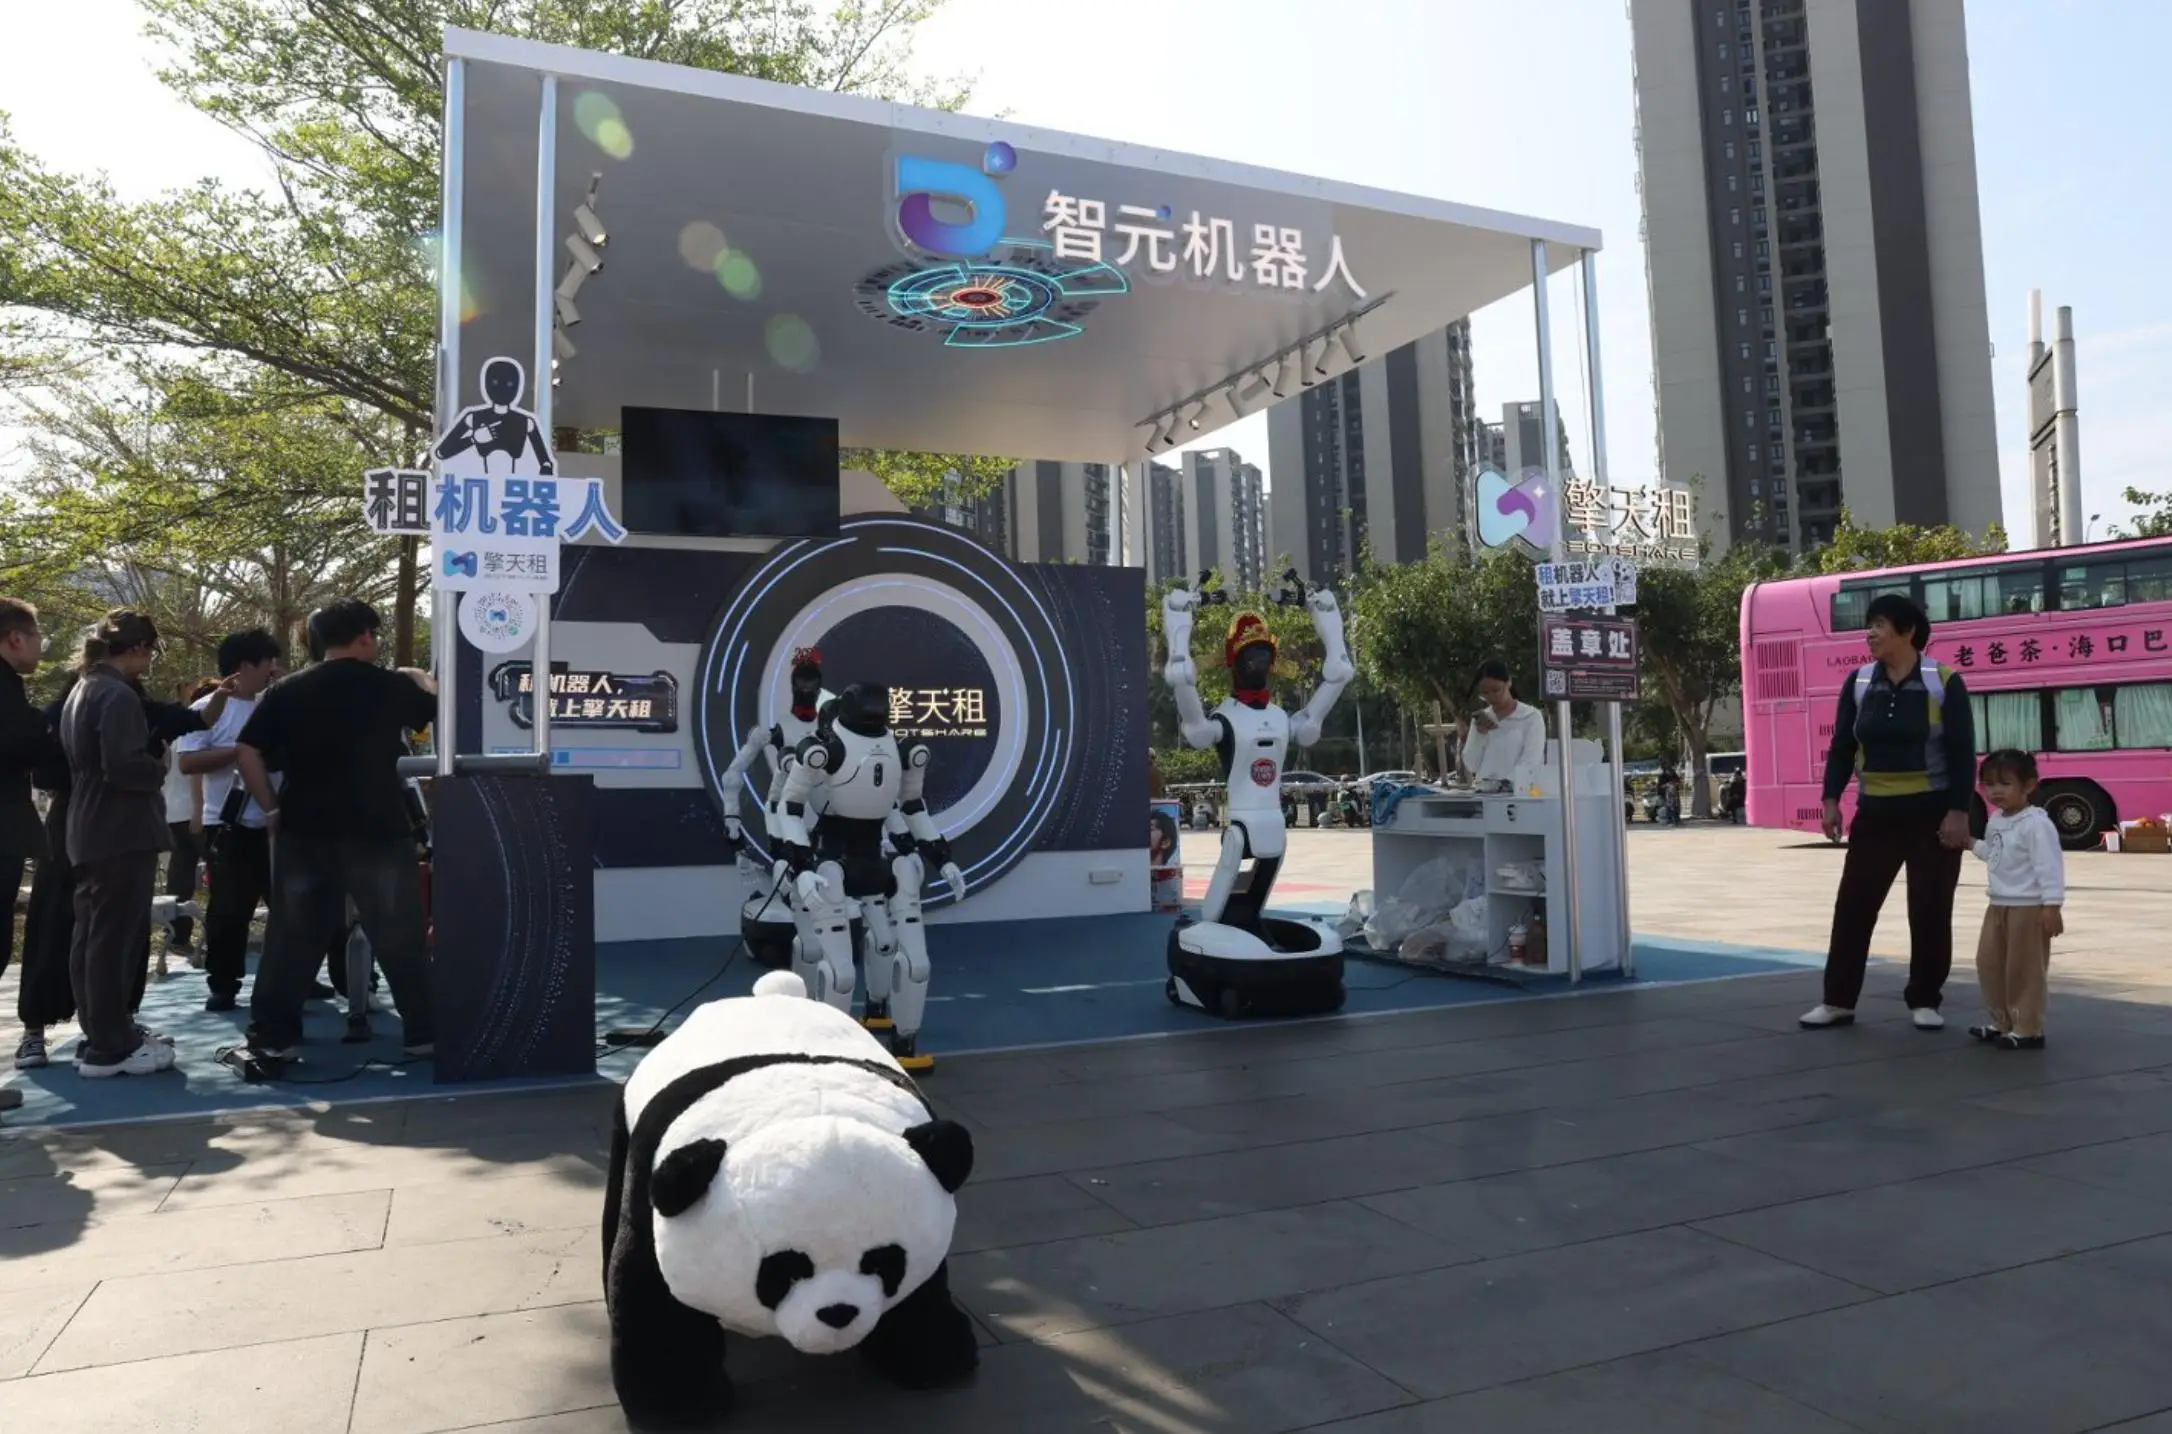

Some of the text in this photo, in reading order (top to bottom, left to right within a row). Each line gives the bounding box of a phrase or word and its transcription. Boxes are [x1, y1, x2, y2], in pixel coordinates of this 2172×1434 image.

[1043, 189, 1368, 299] 智元机器人
[368, 471, 625, 543] 租机器人
[1564, 478, 1696, 539] 擎天租
[483, 551, 548, 574] 擎天租
[1566, 540, 1697, 560] BOTSHARE
[1551, 628, 1630, 658] 盖章处
[888, 686, 987, 724] 擎天租
[895, 728, 988, 737] OTSHARE
